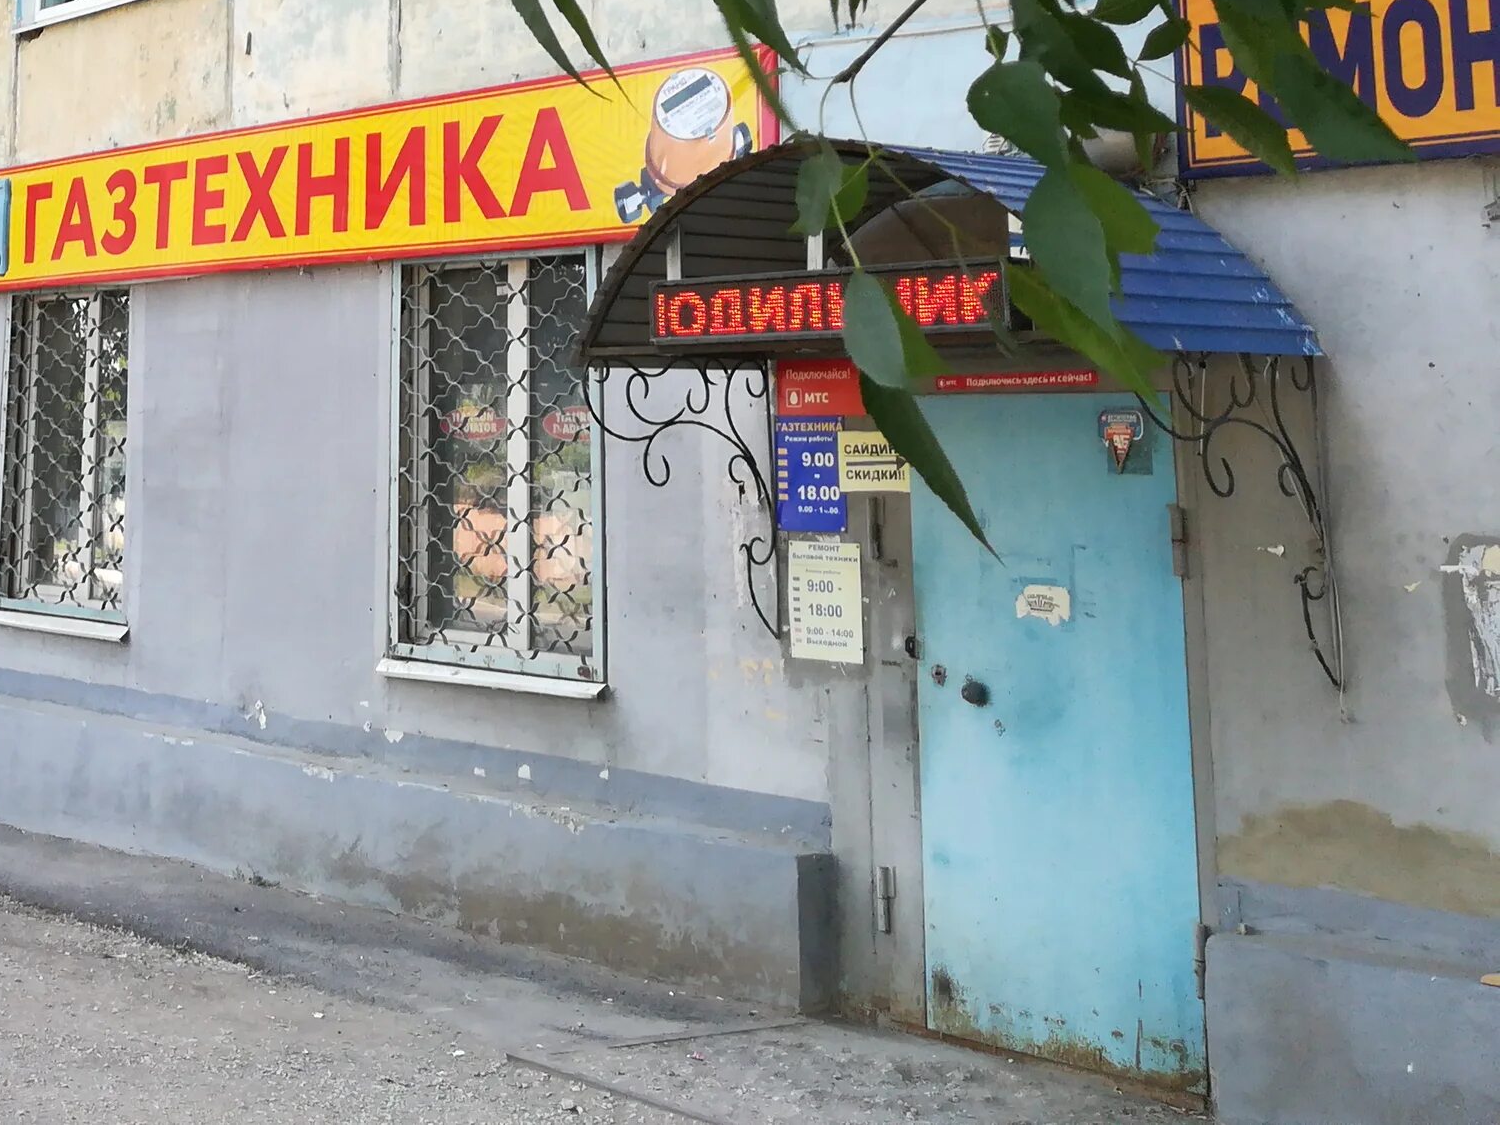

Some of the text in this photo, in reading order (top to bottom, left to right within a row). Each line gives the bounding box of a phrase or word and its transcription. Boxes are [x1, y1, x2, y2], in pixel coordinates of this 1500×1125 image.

[24, 107, 591, 264] ГАЗТЕХНИКА
[785, 368, 851, 380] Подключайся!
[966, 377, 1022, 387] Подключись
[1022, 375, 1048, 386] здесь
[1057, 372, 1092, 382] сейчас!
[804, 392, 829, 403] МТС
[776, 422, 843, 432] ГАЗТЕХНИКА
[808, 435, 833, 443] работы
[801, 452, 834, 467] 9.00
[797, 485, 840, 501] 18.00
[808, 544, 841, 553] РЕМОНТ
[825, 555, 858, 563] техники
[806, 579, 834, 593] 9:00
[807, 603, 843, 618] 18:00
[806, 626, 824, 636] 9:00
[831, 628, 854, 638] 14:00
[806, 637, 848, 648] Выходной
